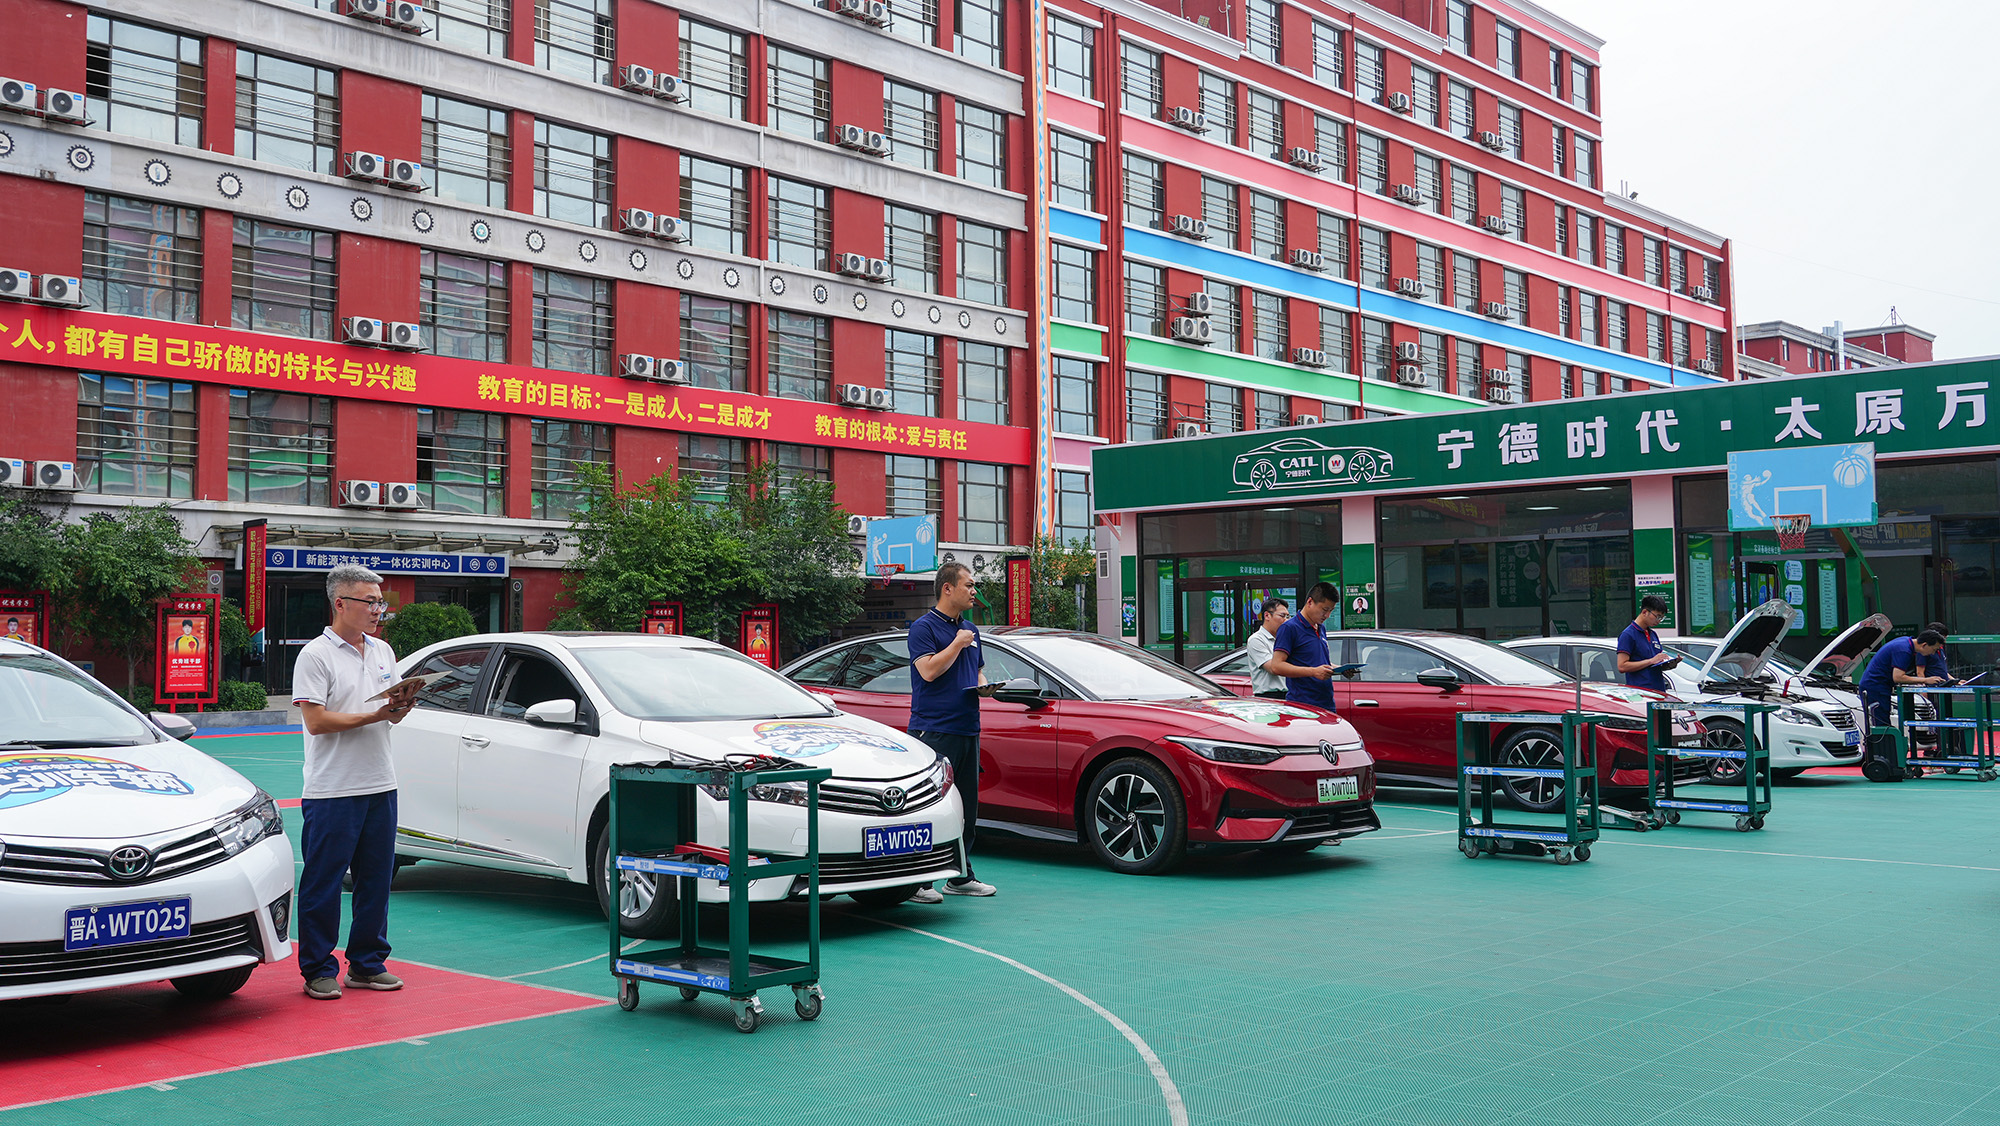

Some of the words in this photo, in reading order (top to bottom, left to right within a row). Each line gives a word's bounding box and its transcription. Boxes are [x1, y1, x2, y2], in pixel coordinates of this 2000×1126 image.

[0, 318, 417, 392] 人，都有自己骄傲的特长与兴趣
[1279, 456, 1319, 470] CATL
[305, 553, 452, 570] 新能源汽车工学一体化实训中心
[867, 828, 931, 853] 晋A·WT052
[69, 905, 187, 942] 晋A·WT025
